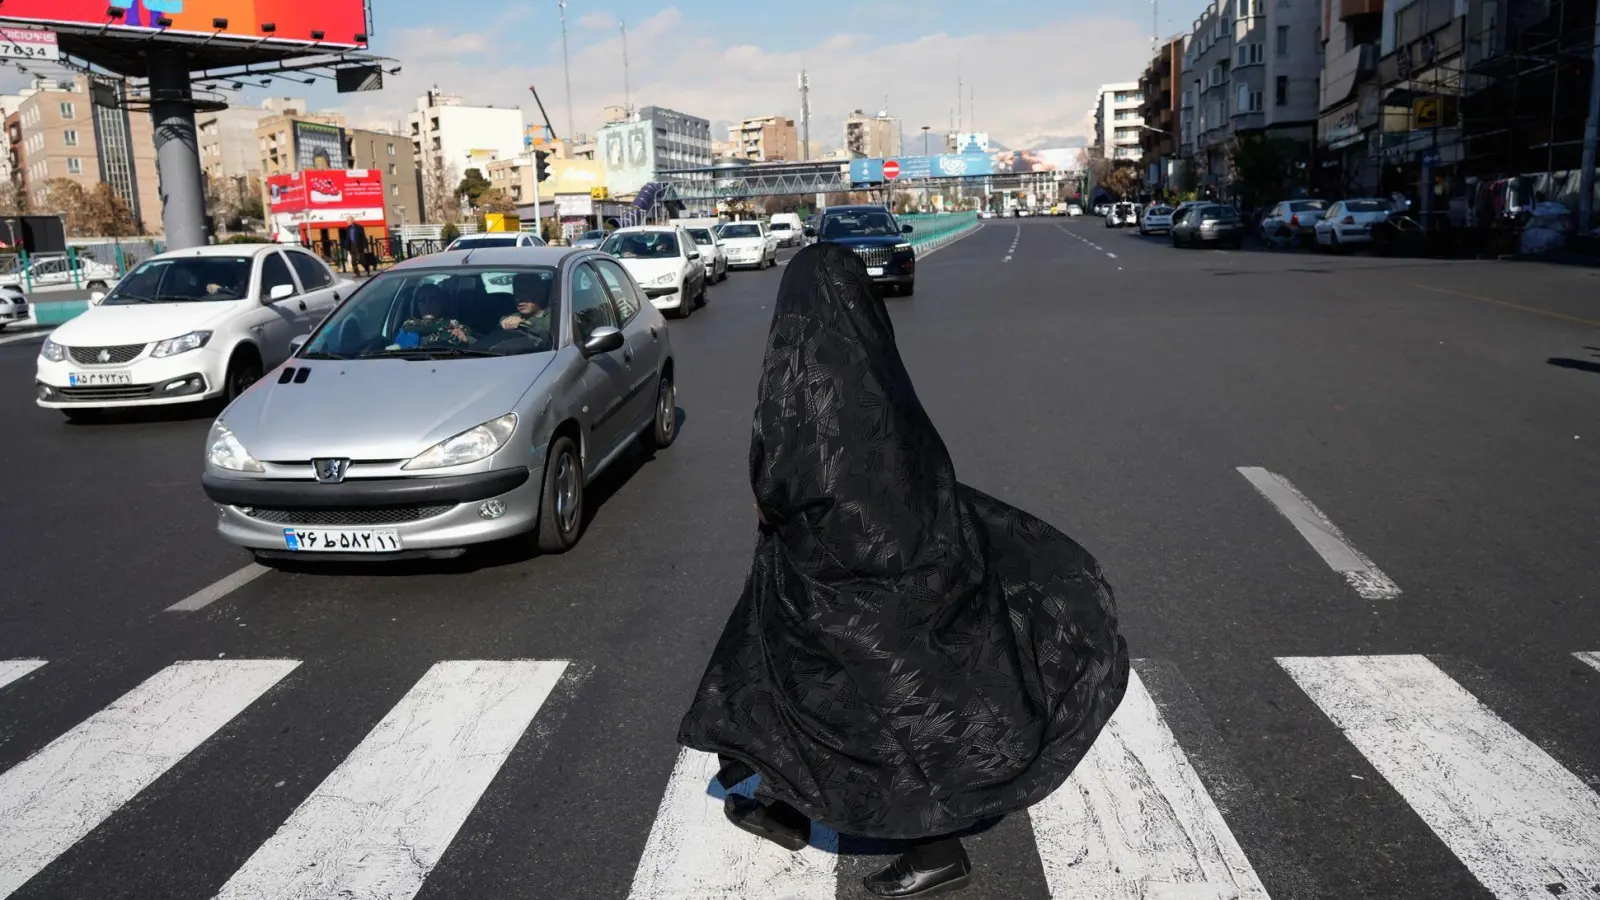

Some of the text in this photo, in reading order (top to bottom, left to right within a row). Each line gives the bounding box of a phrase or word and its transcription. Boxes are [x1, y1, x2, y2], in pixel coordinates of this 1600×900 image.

[296, 531, 317, 547] ۲۶
[324, 532, 336, 548] ط
[340, 532, 370, 548] ۵۸۲
[378, 535, 397, 549] ۱۱
